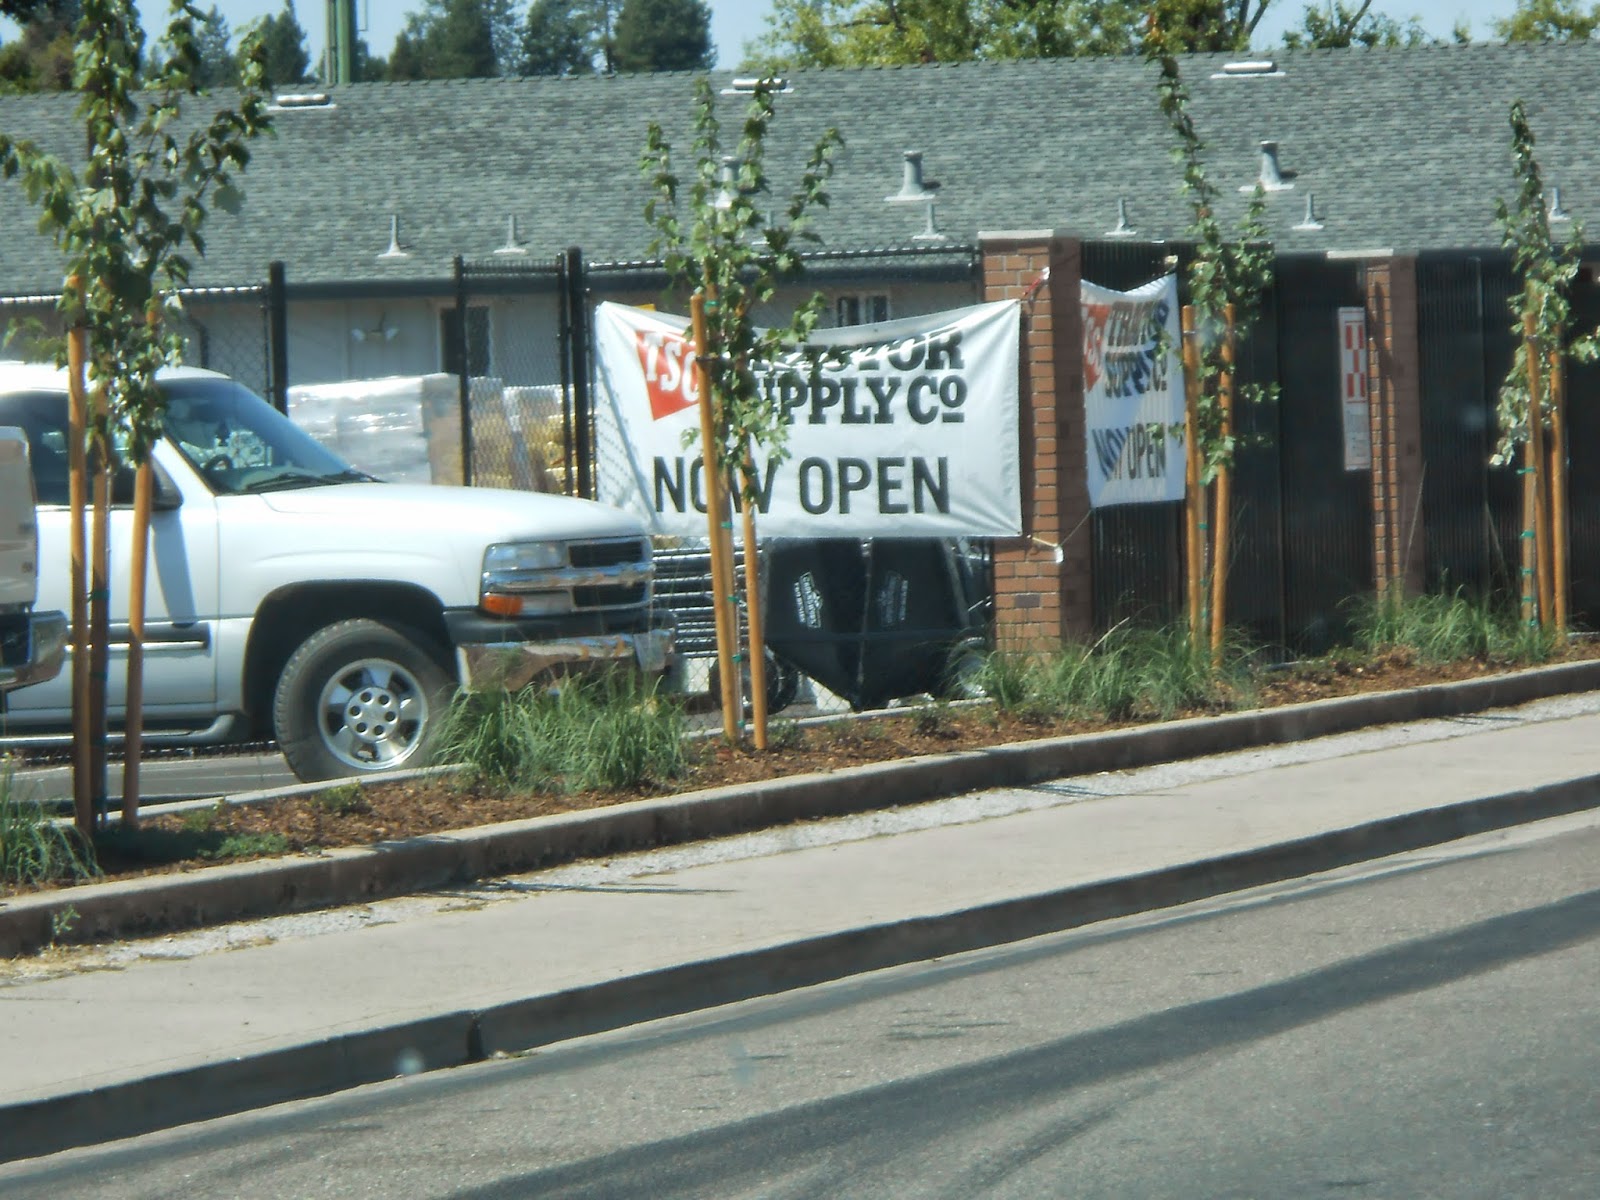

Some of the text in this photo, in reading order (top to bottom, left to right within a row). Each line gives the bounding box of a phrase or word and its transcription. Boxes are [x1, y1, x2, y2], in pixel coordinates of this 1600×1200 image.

[644, 331, 699, 402] TSC
[750, 328, 966, 372] CTOR
[748, 376, 901, 425] UPPLY
[799, 456, 950, 515] OPEN
